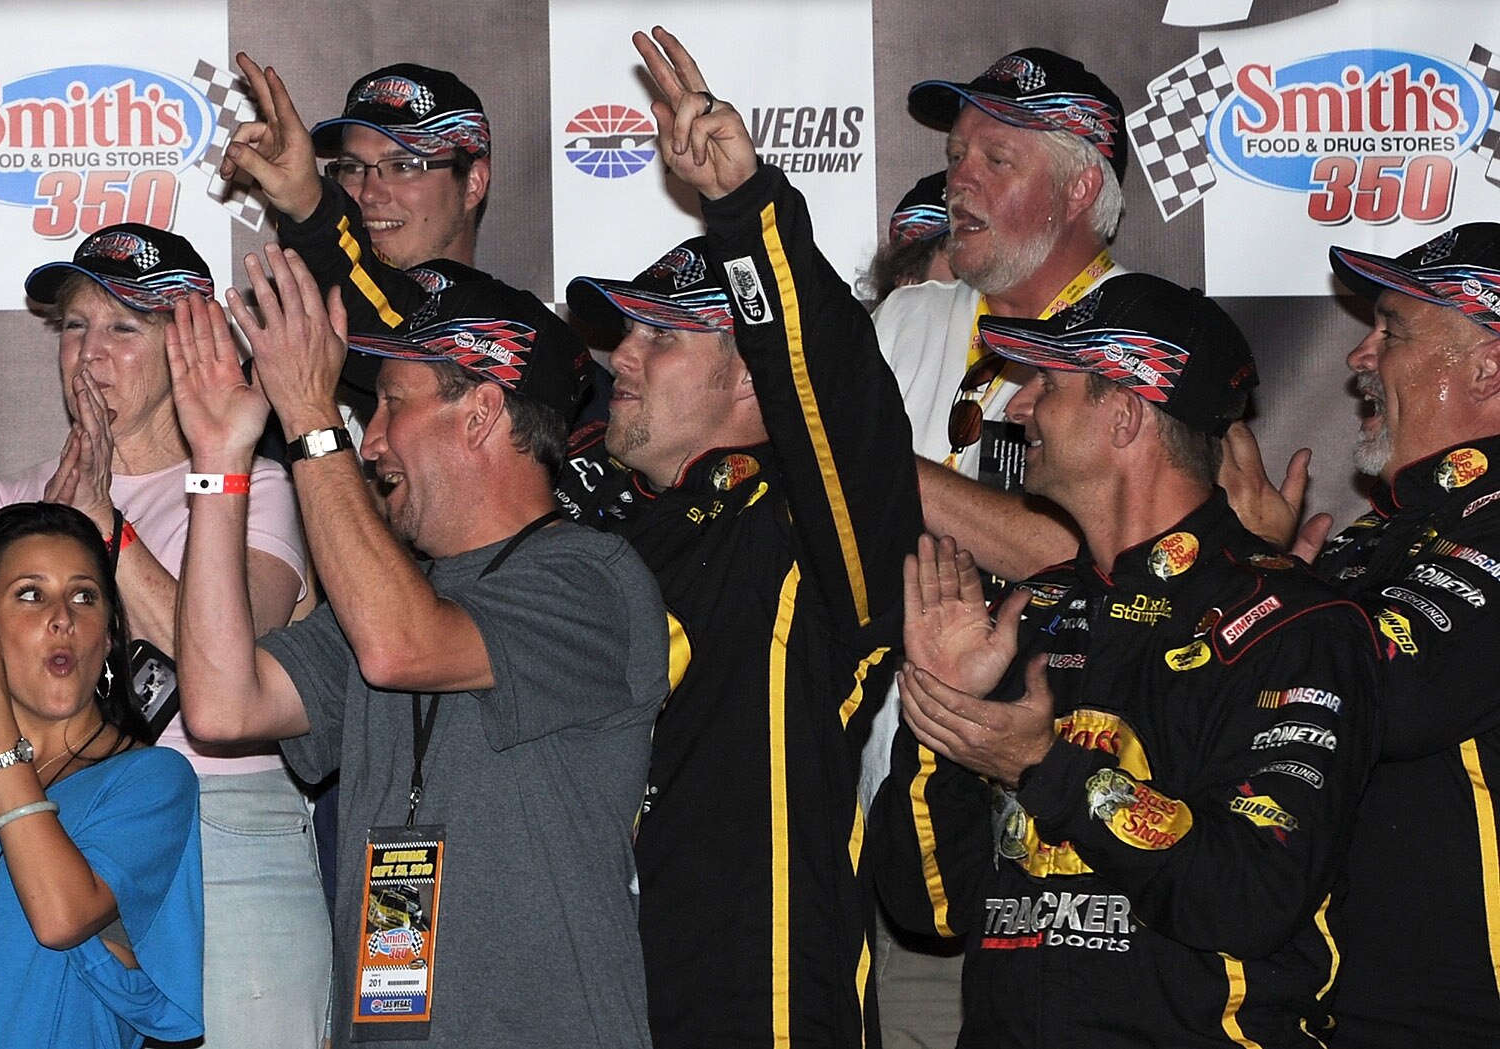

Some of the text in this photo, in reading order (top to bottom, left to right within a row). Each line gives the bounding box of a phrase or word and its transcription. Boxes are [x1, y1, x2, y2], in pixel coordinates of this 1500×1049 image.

[1236, 63, 1460, 134] Smith's
[752, 105, 864, 149] VEGAS
[1247, 136, 1456, 154] FOOD & DRUG STORES
[31, 152, 43, 169] &
[49, 151, 100, 169] DRUG
[105, 151, 180, 168] STORES
[758, 152, 864, 173] PEEDWAY
[33, 170, 180, 238] 350
[1308, 155, 1459, 226] 350
[475, 338, 515, 361] LAS VEGAS
[1123, 353, 1162, 382] LAS VEGAS
[1225, 598, 1278, 641] SIMPSON
[1284, 686, 1342, 713] NASCAR
[1133, 783, 1178, 815] Bass
[1233, 797, 1298, 828] SUNOCO
[1129, 801, 1164, 825] Pro
[1122, 813, 1178, 848] Shops
[409, 862, 434, 876] 2010
[985, 892, 1132, 935] TRACKER
[380, 931, 411, 944] Smith's
[1046, 930, 1131, 952] boats
[368, 978, 381, 988] 201
[382, 999, 412, 1009] LAS VEGAS
